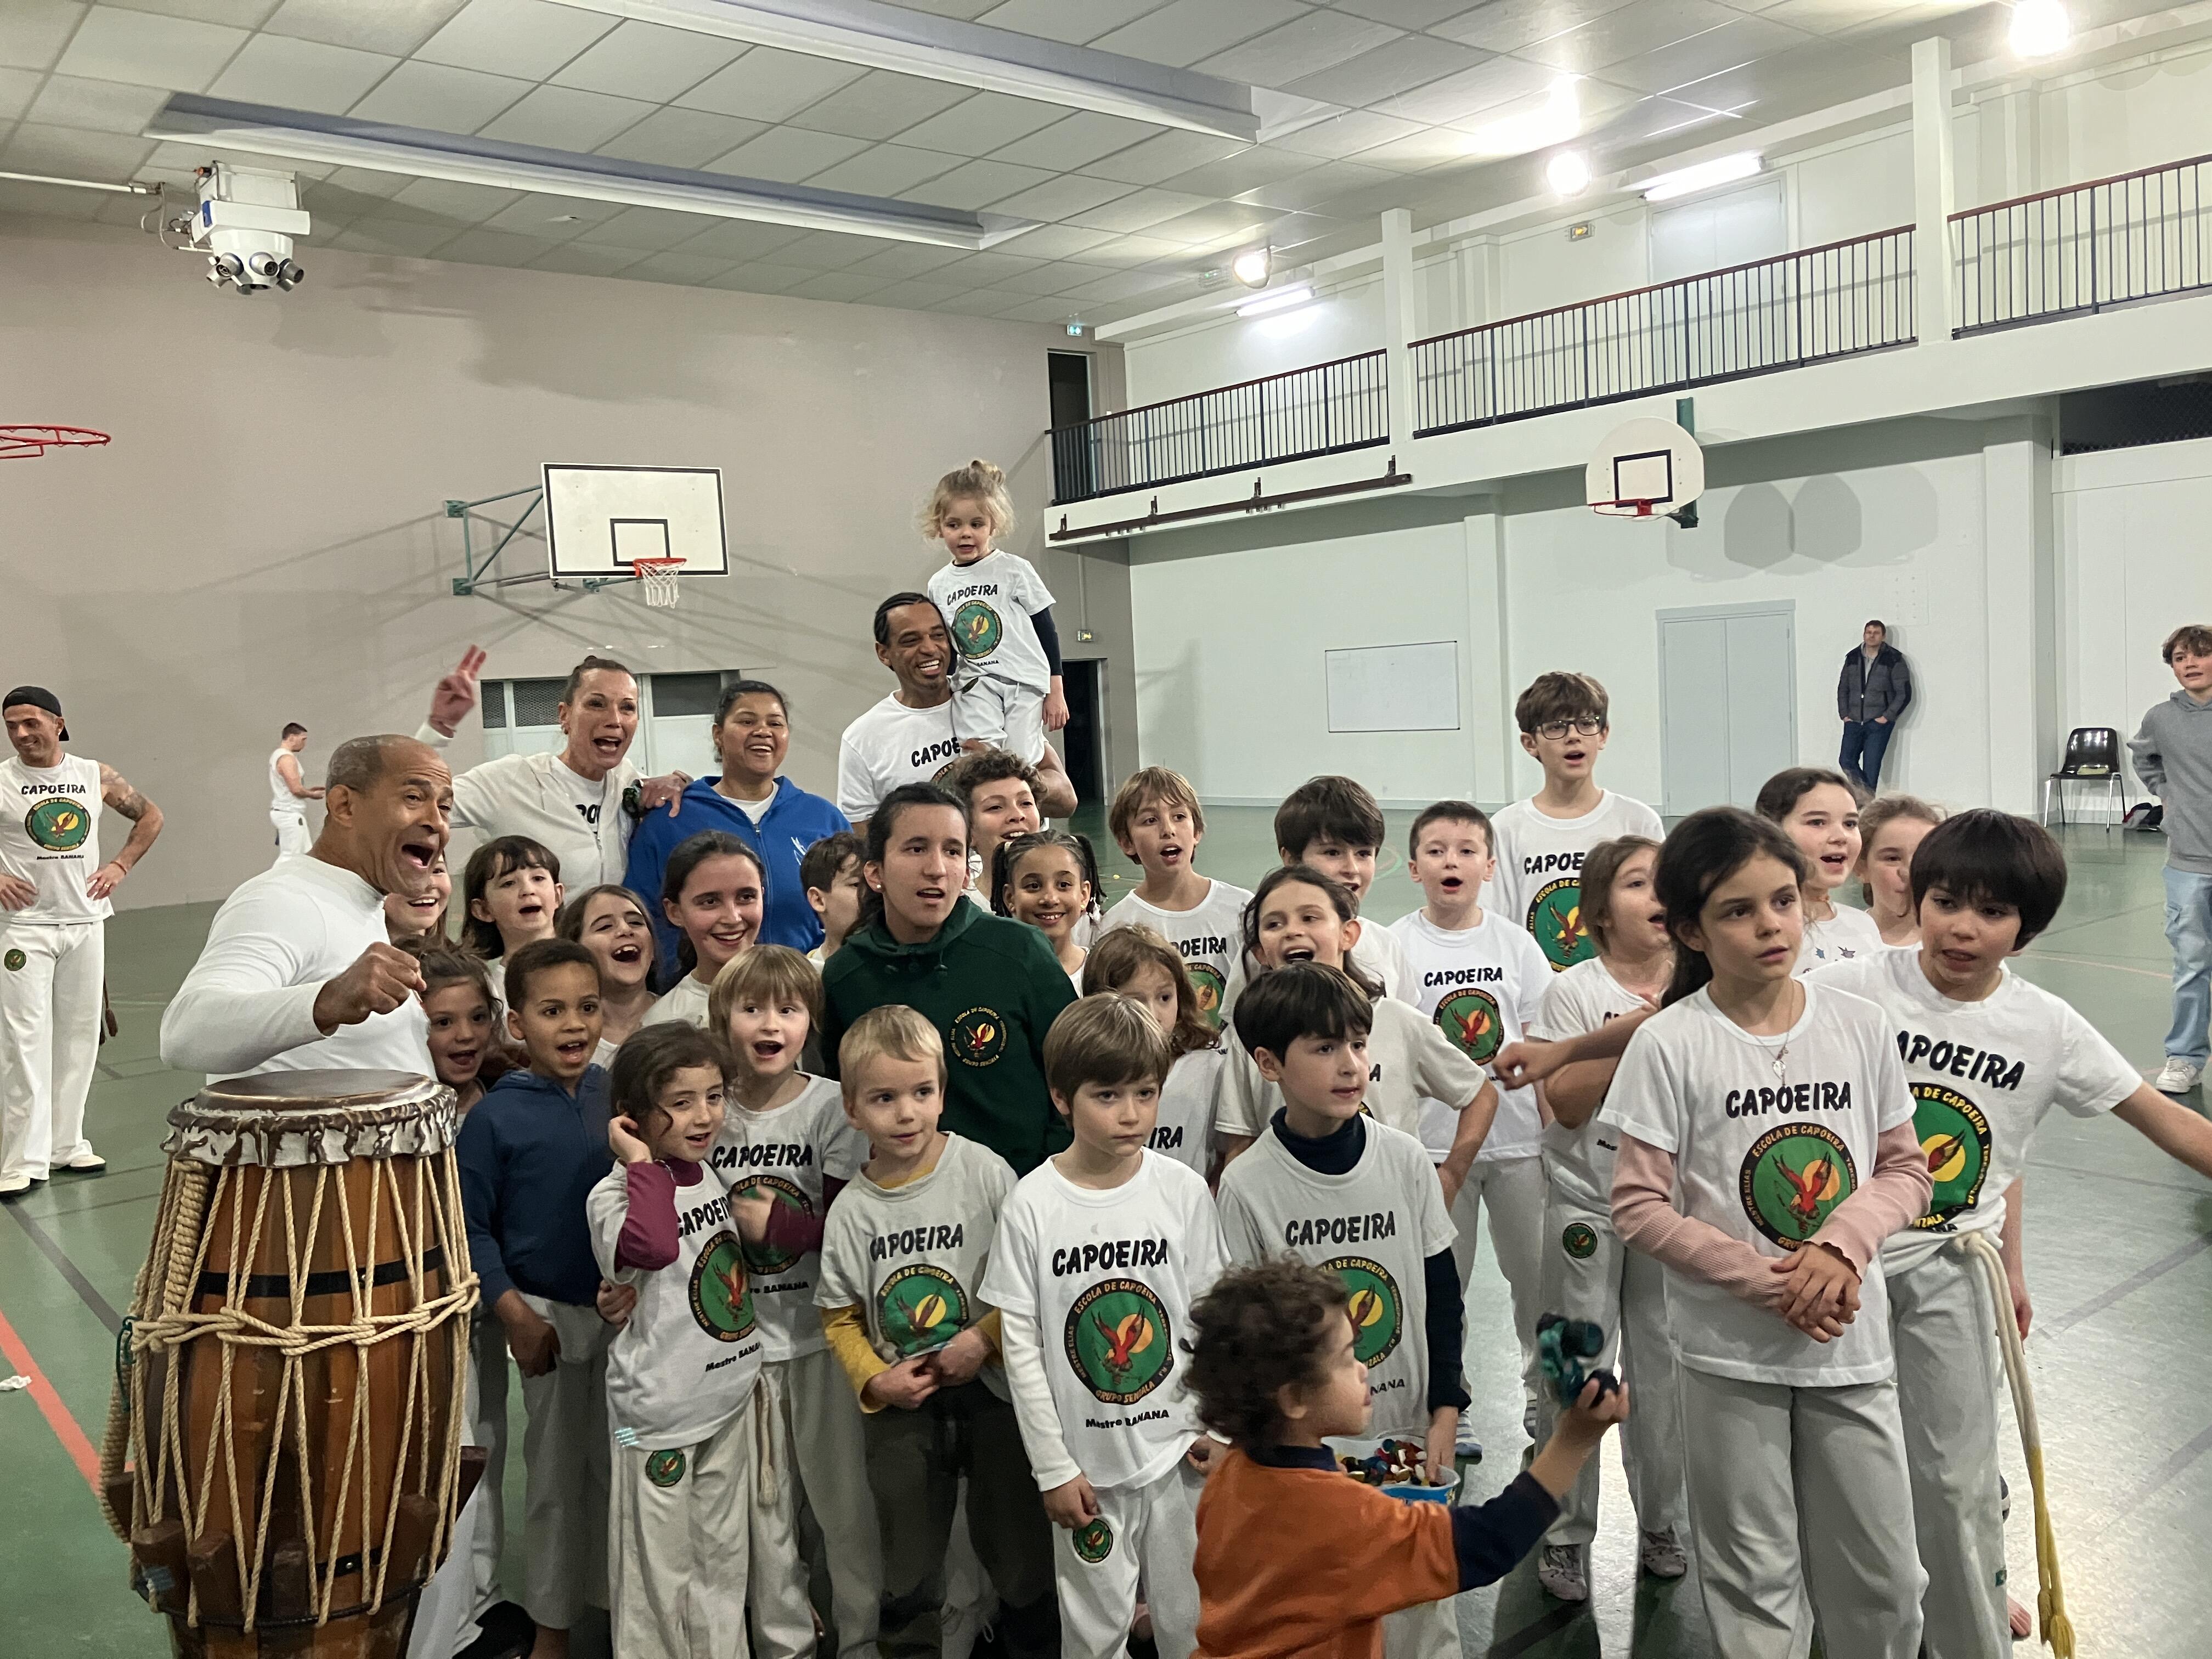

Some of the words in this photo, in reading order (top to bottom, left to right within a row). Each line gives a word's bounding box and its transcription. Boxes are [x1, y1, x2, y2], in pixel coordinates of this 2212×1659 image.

[947, 584, 998, 606] CAPOEIRA
[911, 737, 961, 767] CAPOE
[21, 784, 86, 795] CAPOEIRA
[1524, 852, 1585, 875] CAPOE
[1170, 936, 1227, 958] OEIRA
[1424, 967, 1503, 987] CAPOEIRA
[1897, 1030, 2025, 1091] APOEIRA
[1726, 1081, 1852, 1119] CAPOEIRA
[1923, 1087, 1941, 1098] DE
[1943, 1092, 1987, 1135] CAPOEIRA
[1752, 1130, 1783, 1157] ESCOLA
[1784, 1126, 1798, 1136] DE
[1801, 1125, 1845, 1152] CAPOEIRA
[712, 1144, 813, 1169] CAPOEIRA
[763, 1177, 800, 1198] CAPOEIRA
[1285, 1211, 1396, 1247] CAPOEIRA
[1052, 1238, 1168, 1277] CAPOEIRA
[904, 1267, 916, 1277] DE
[1336, 1259, 1347, 1269] DE
[1351, 1259, 1389, 1282] CAPOEIRA
[1074, 1286, 1102, 1314] ESCOLA
[1104, 1282, 1116, 1292] DE
[1119, 1281, 1156, 1305] CAPOEIRA
[1367, 1352, 1386, 1367] ZALA
[1096, 1390, 1122, 1402] GRUPO
[1370, 1379, 1405, 1396] NANA
[1125, 1409, 1170, 1426] BANANA
